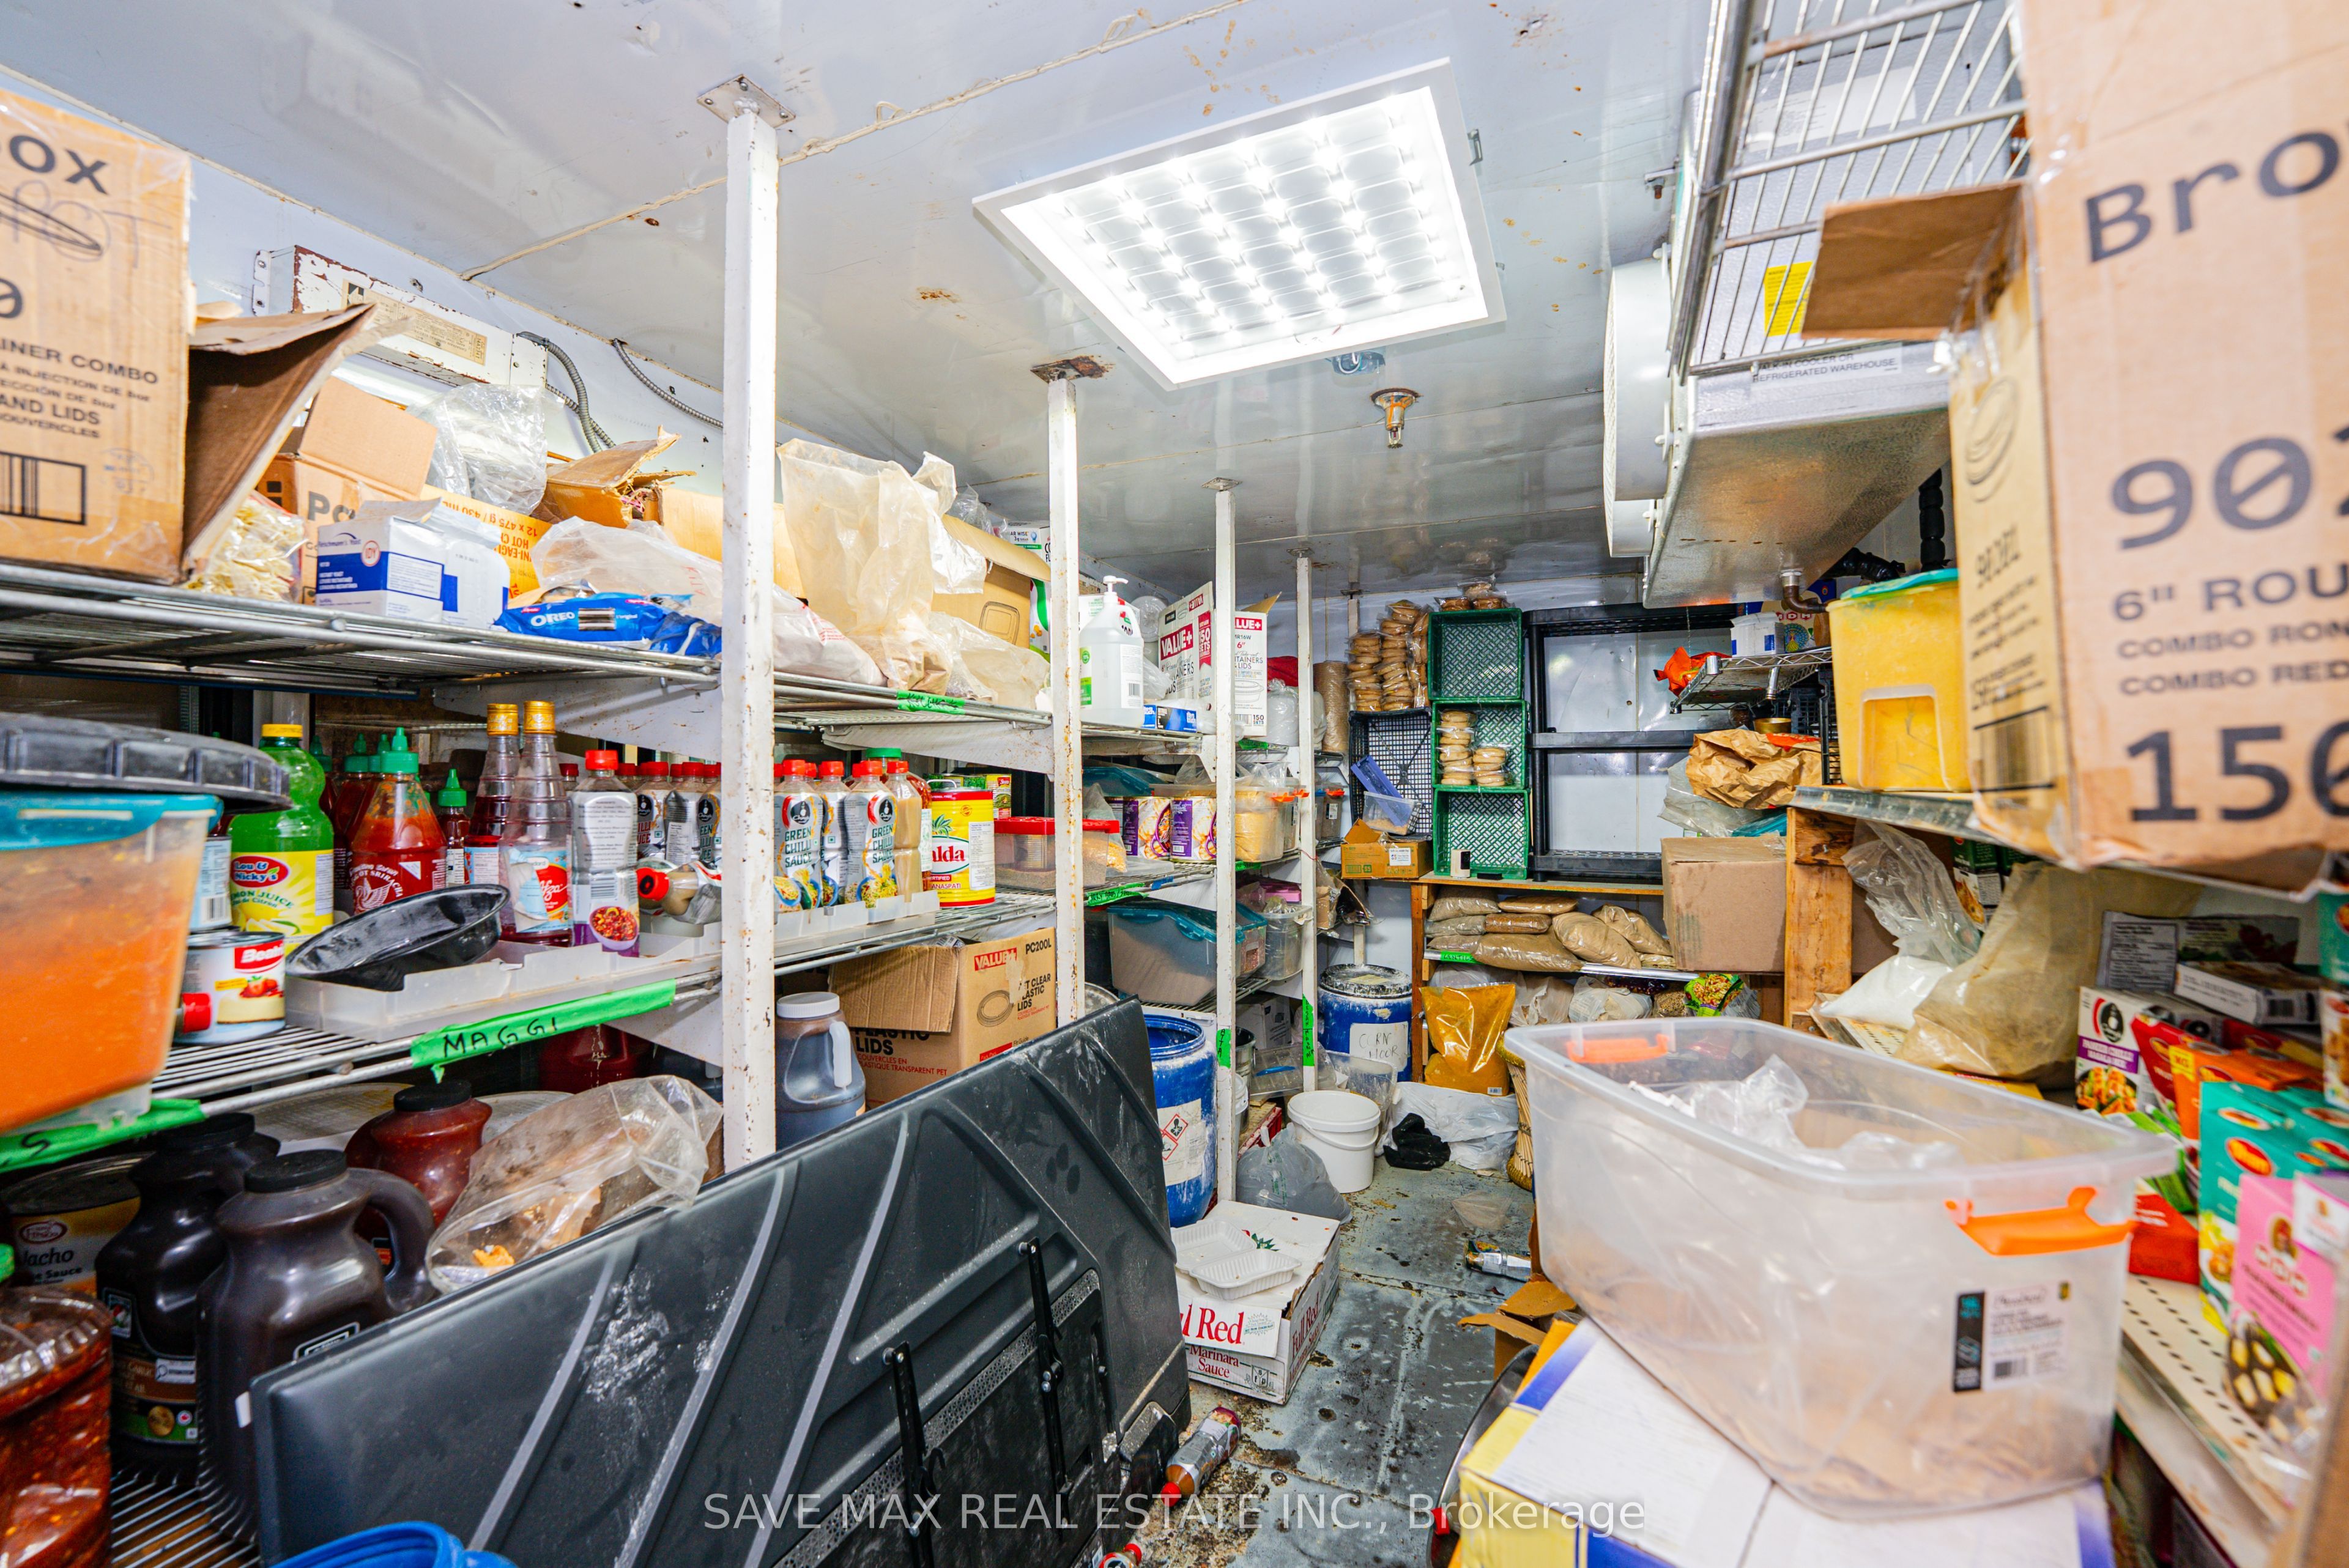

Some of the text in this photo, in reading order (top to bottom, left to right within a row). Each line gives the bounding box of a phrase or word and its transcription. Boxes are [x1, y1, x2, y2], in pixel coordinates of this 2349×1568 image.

[0, 135, 109, 196] OX
[2085, 124, 2348, 264] Bro
[0, 338, 159, 385] INER COMBO
[1760, 353, 1854, 371] ALK-IN COOLER OR
[1753, 358, 1896, 383] REFRIGERATED WAREHOUSE
[0, 393, 101, 426] AND LIDS
[2110, 423, 2349, 550] 90
[499, 519, 516, 530] 475
[527, 526, 538, 537] 12
[512, 538, 529, 549] HOT
[530, 611, 576, 627] OREO
[1235, 619, 1261, 630] LUE+
[1161, 629, 1193, 657] VALUE+
[1198, 629, 1211, 643] 150
[2118, 628, 2255, 659] COMBO
[1198, 643, 1211, 653] SETS
[2119, 667, 2257, 696] COMBO
[637, 821, 651, 832] ILLI
[785, 826, 811, 842] GREEN
[872, 824, 893, 838] GREEN
[785, 839, 811, 855] CHILLI
[872, 836, 893, 851] CHILLI
[785, 852, 812, 868] SAUCE
[872, 849, 893, 864] SAUCE
[234, 862, 254, 870] Lou
[234, 871, 278, 882] Nicky's
[258, 891, 295, 909] JUICE
[1025, 937, 1052, 955] PC200L
[1031, 973, 1051, 988] CLEAR
[1022, 985, 1045, 1000] LASTIC
[1017, 999, 1033, 1012] LIDS
[443, 1016, 557, 1058] MAGGI
[855, 1037, 894, 1056] LIDS
[857, 1053, 897, 1064] COUVERCLES
[891, 1064, 935, 1074] TRANSPARENT
[45, 1267, 83, 1279] Sauce
[1196, 1306, 1245, 1345] Red
[1292, 1291, 1320, 1360] Full Red
[1189, 1344, 1239, 1367] Marinara
[1198, 1357, 1230, 1378] Sauce
